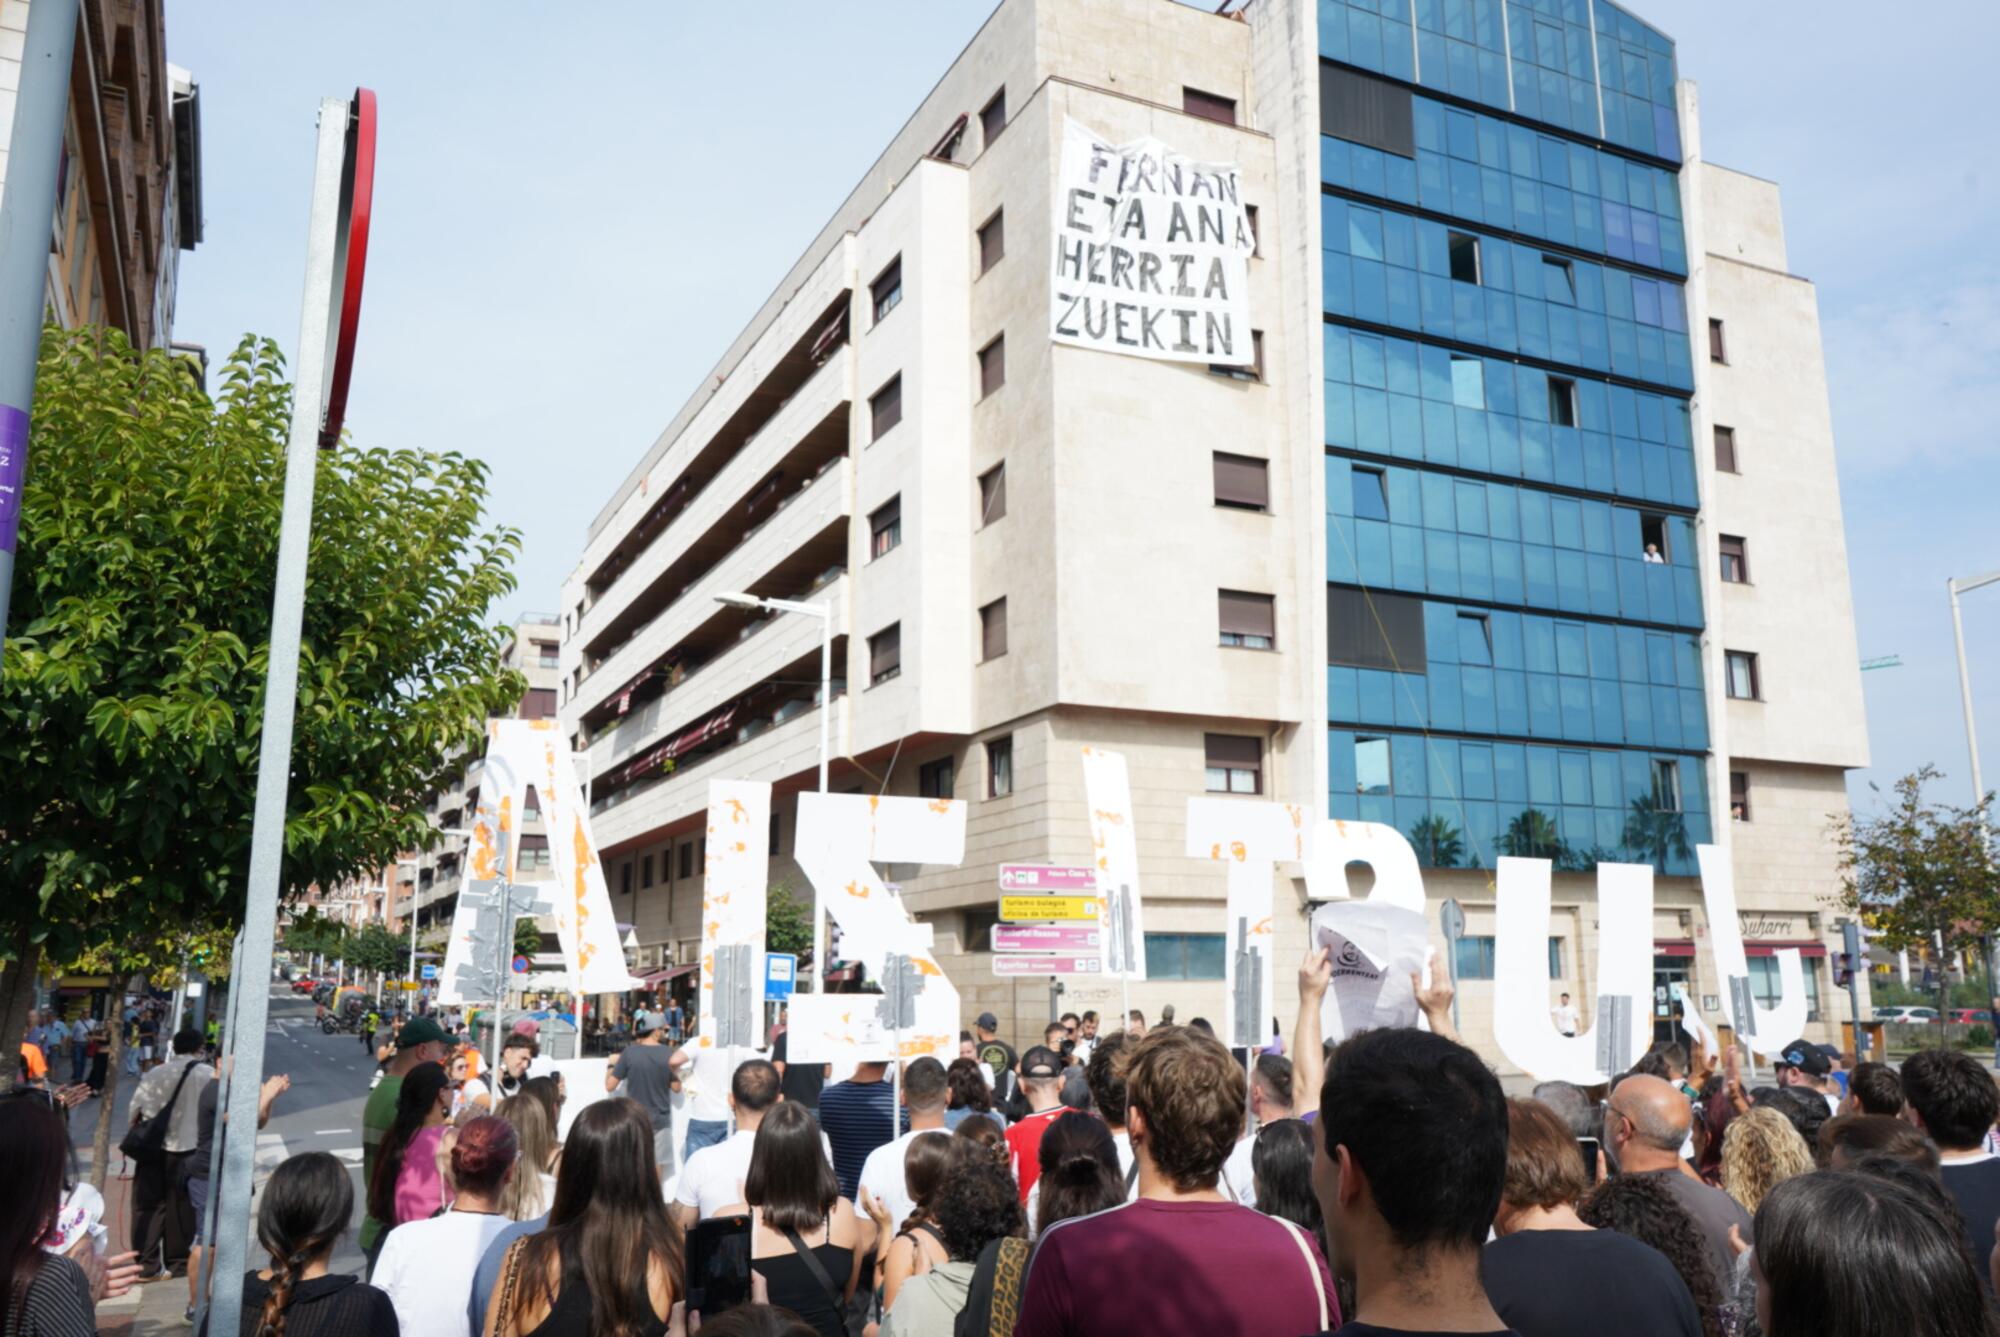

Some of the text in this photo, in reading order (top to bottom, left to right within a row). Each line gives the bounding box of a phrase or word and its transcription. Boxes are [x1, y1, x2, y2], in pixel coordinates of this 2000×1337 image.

[1066, 188, 1251, 250] ETA ANA
[1057, 234, 1229, 300] HERRIA
[1056, 292, 1234, 357] ZUEKIN
[1738, 911, 1793, 939] Suharri
